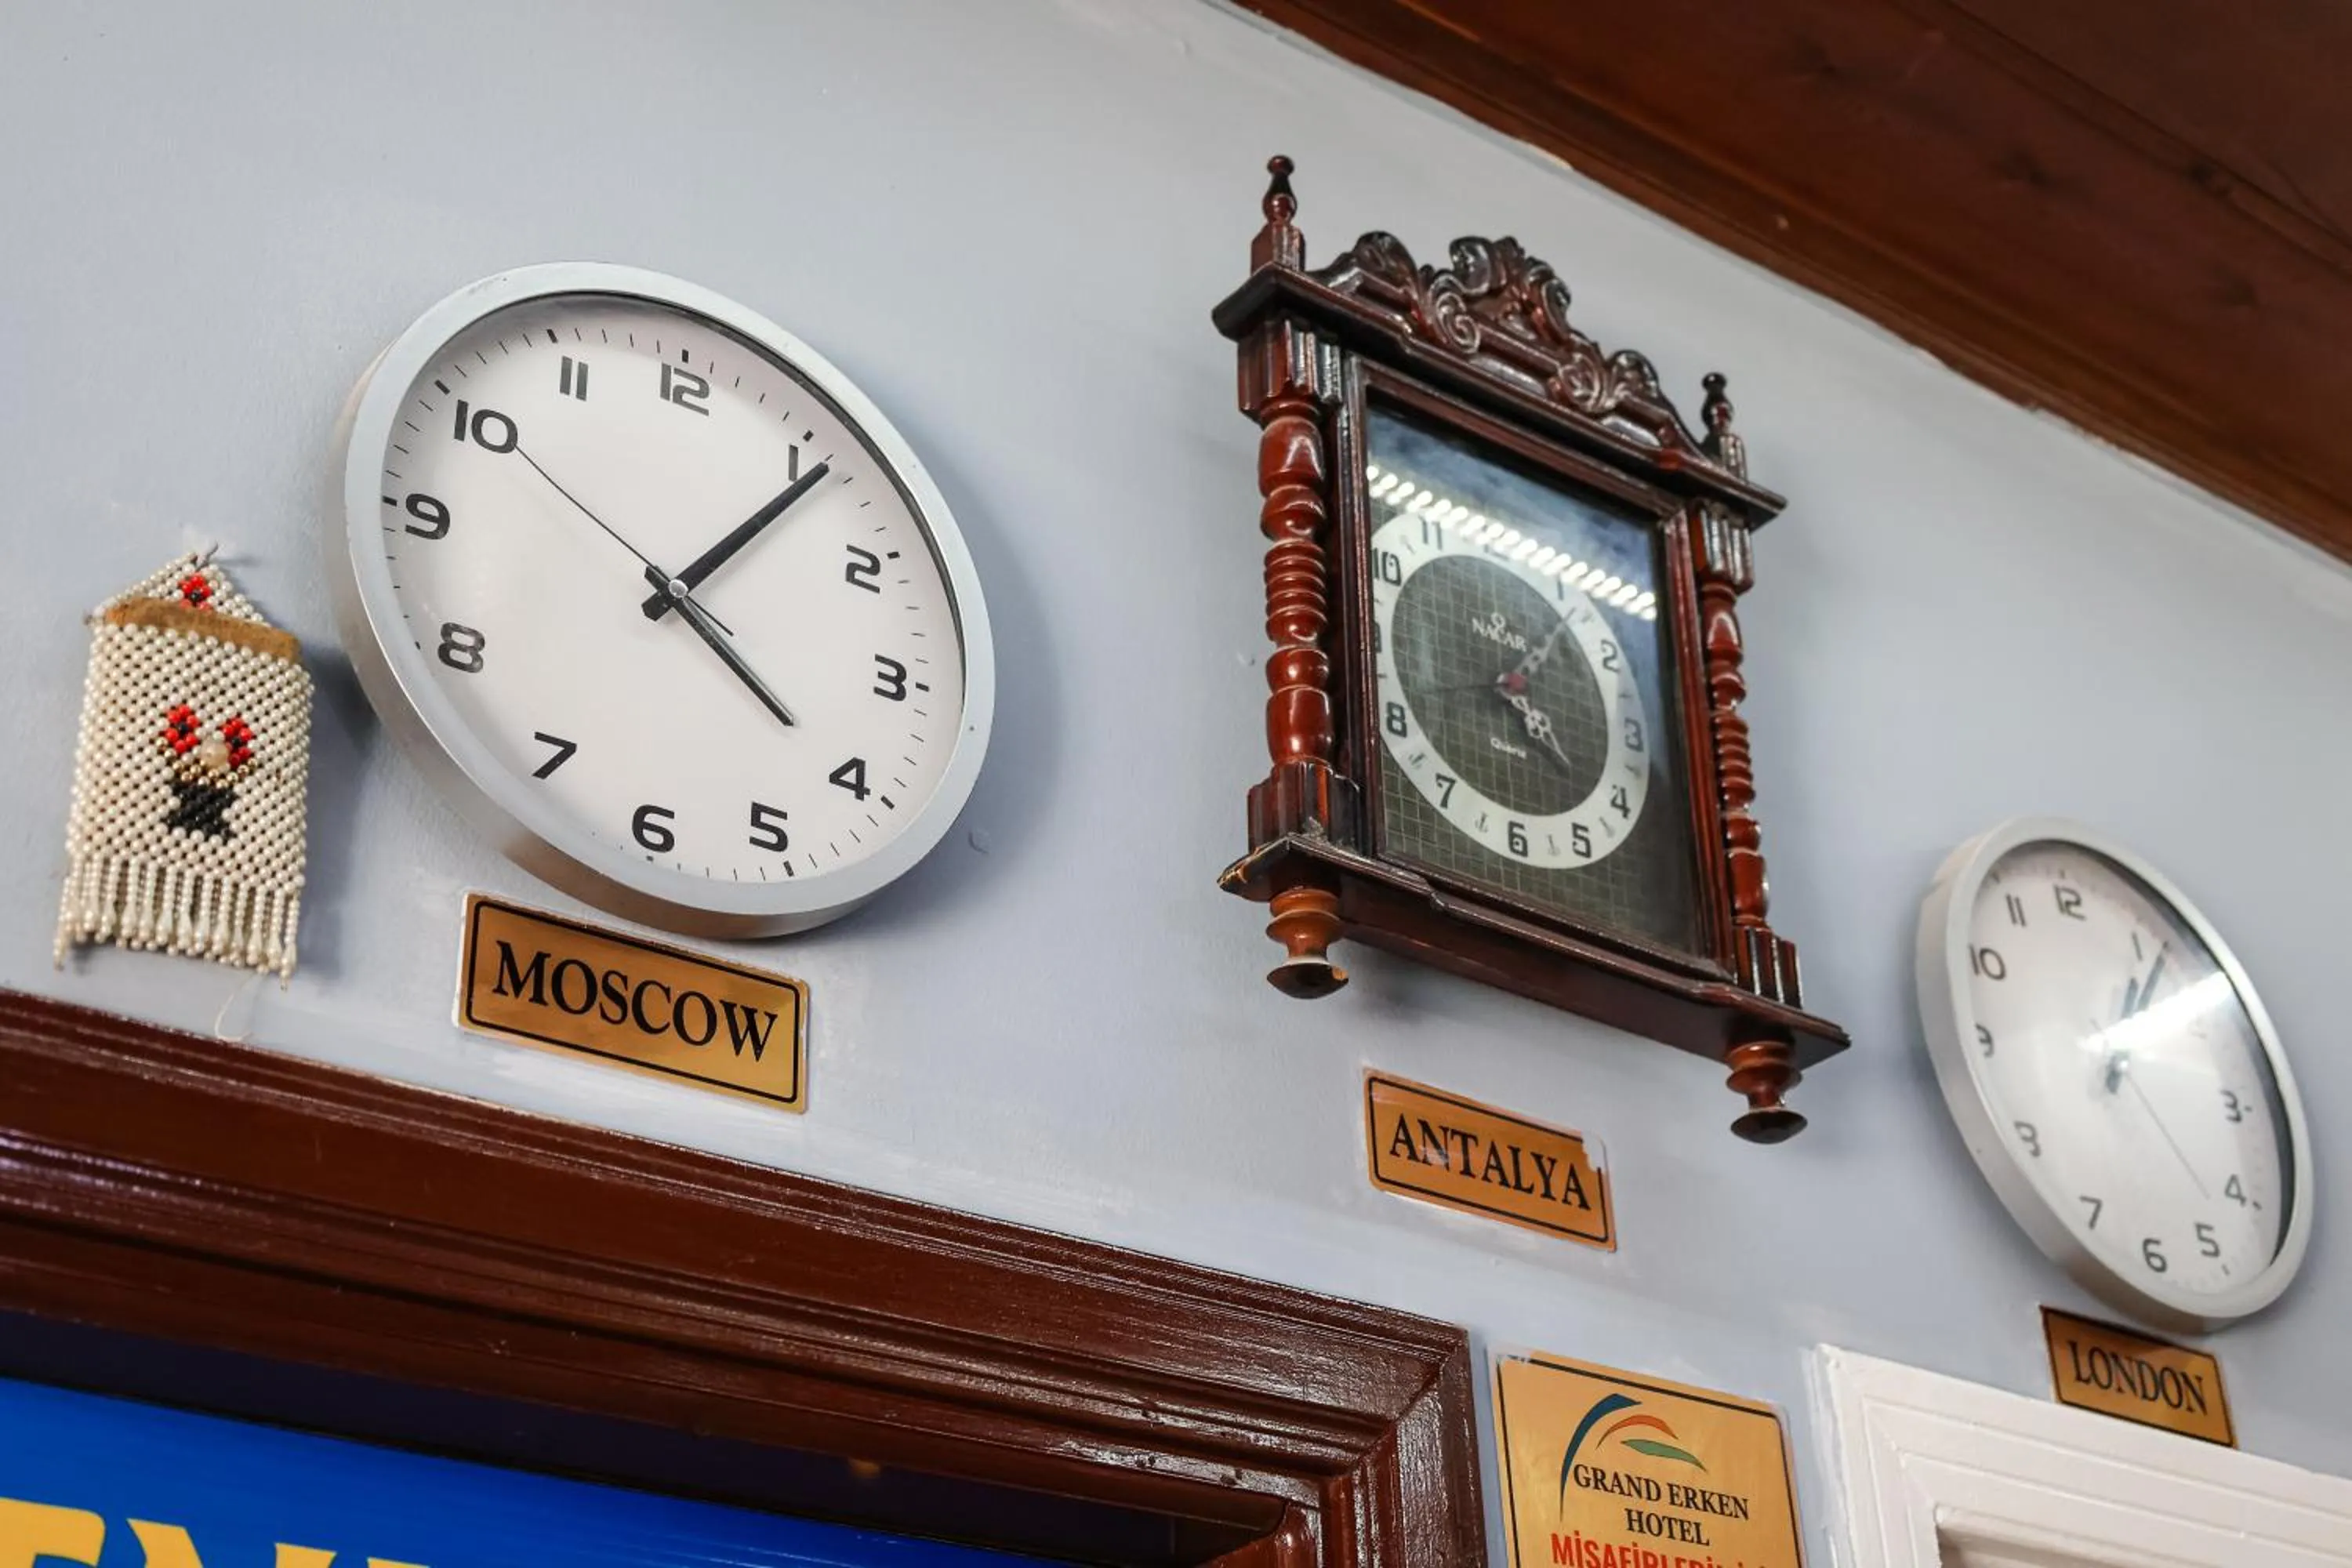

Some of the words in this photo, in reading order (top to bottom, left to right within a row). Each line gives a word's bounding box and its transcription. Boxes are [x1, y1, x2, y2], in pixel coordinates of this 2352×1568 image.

[559, 355, 588, 401] 11
[659, 362, 710, 416] 12
[452, 399, 518, 455] 10
[788, 444, 799, 482] 1
[404, 493, 451, 540] 9
[845, 544, 882, 593] 2
[1370, 546, 1402, 587] 10
[437, 622, 487, 673] 8
[1600, 639, 1621, 673] 2
[873, 654, 908, 702] 3
[1386, 701, 1408, 739] 8
[1624, 717, 1644, 753] 3
[532, 731, 578, 780] 7
[828, 756, 871, 801] 4
[1435, 772, 1457, 810] 7
[1610, 783, 1632, 819] 4
[631, 804, 677, 854] 6
[749, 802, 790, 853] 5
[1507, 820, 1529, 858] 6
[1570, 822, 1592, 859] 5
[1969, 943, 2007, 982] 10
[492, 939, 779, 1062] MOSCOW
[1389, 1112, 1592, 1211] ANTALYA
[2223, 1174, 2247, 1207] 4
[2078, 1195, 2103, 1231] 7
[2142, 1237, 2169, 1274] 6
[2194, 1221, 2222, 1258] 5
[2066, 1340, 2209, 1417] LONDON
[1573, 1463, 1662, 1503] GRAND
[1667, 1482, 1750, 1521] ERKEN
[1624, 1508, 1711, 1547] HOTEL
